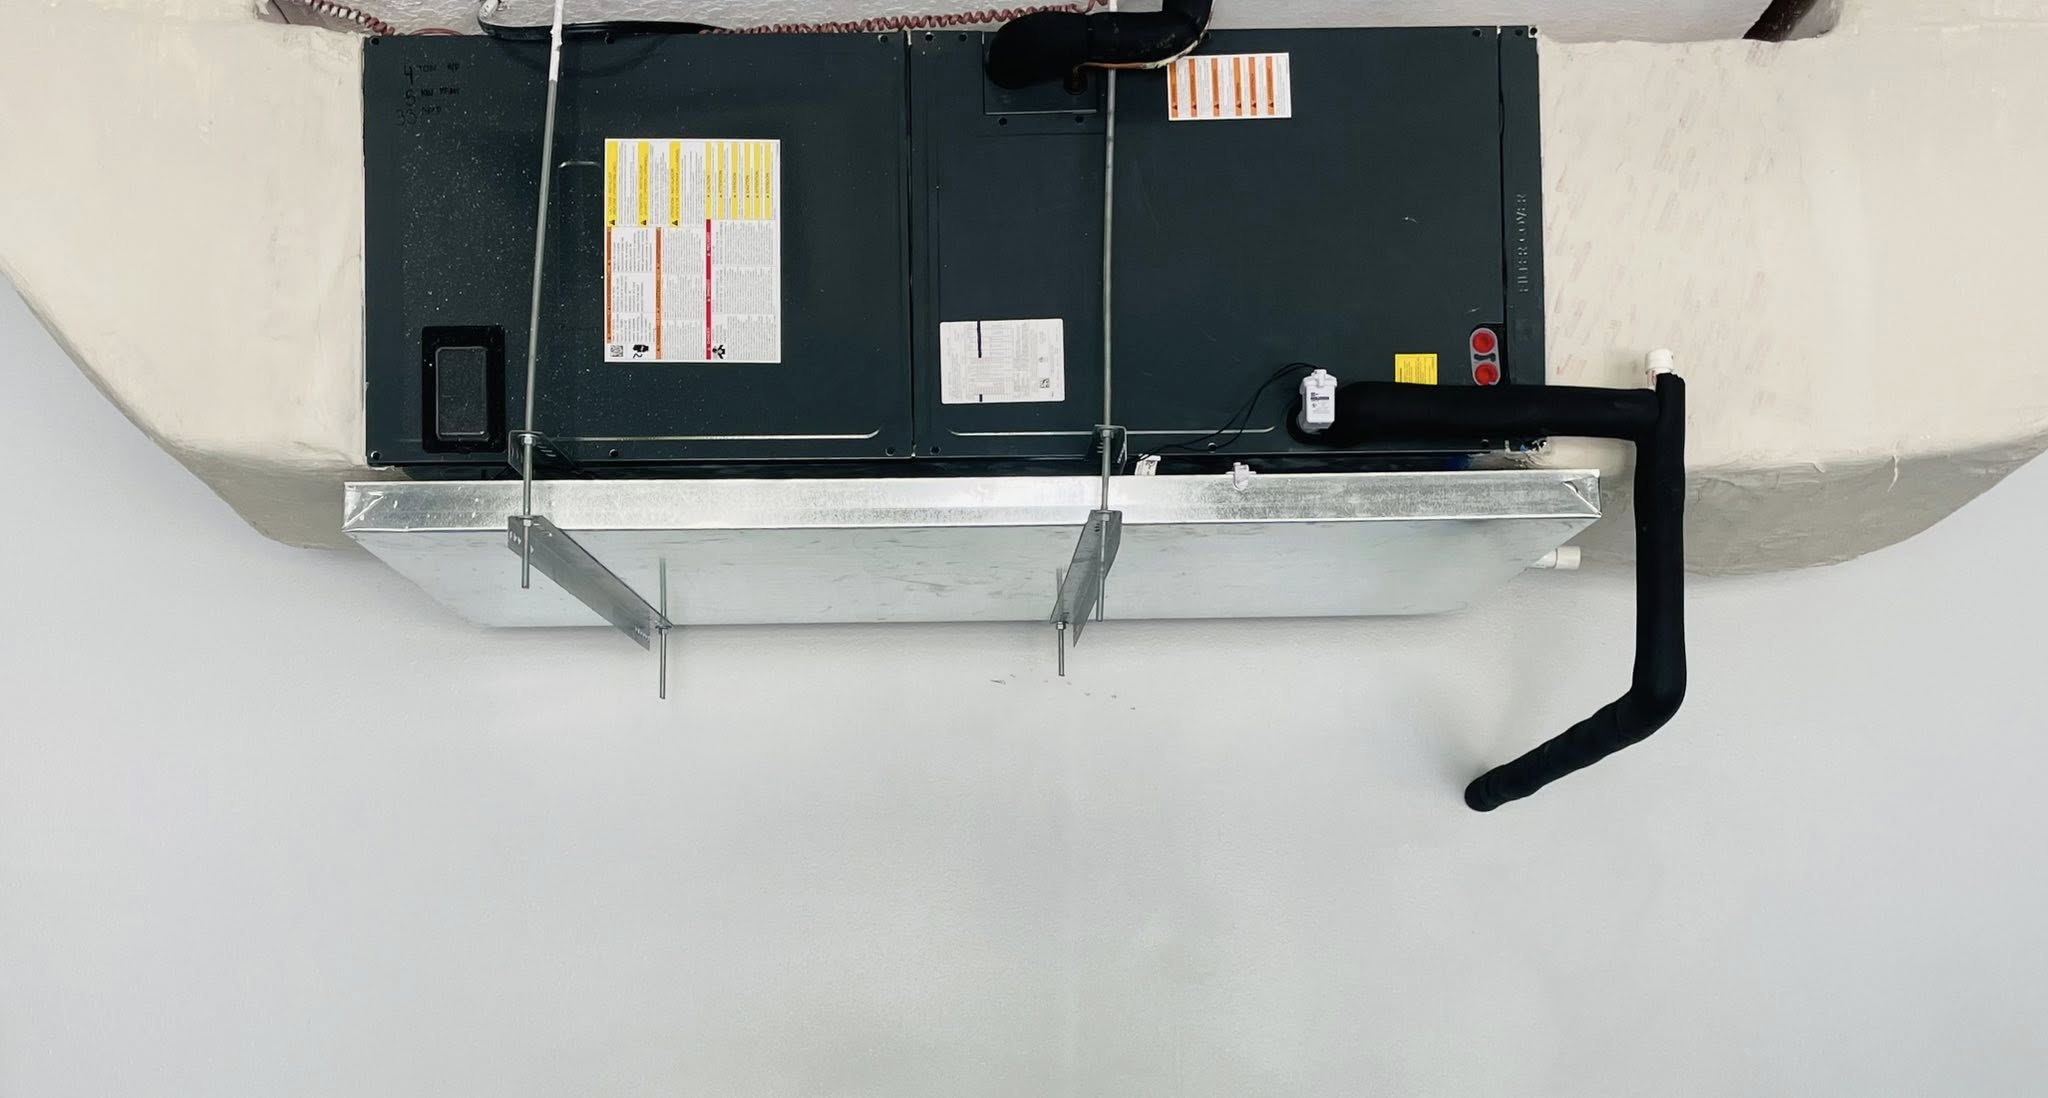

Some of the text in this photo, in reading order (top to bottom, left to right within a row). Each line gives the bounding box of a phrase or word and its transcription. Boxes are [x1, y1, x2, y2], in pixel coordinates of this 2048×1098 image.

[403, 64, 413, 85] 4
[1515, 193, 1529, 294] FILTER COVER
